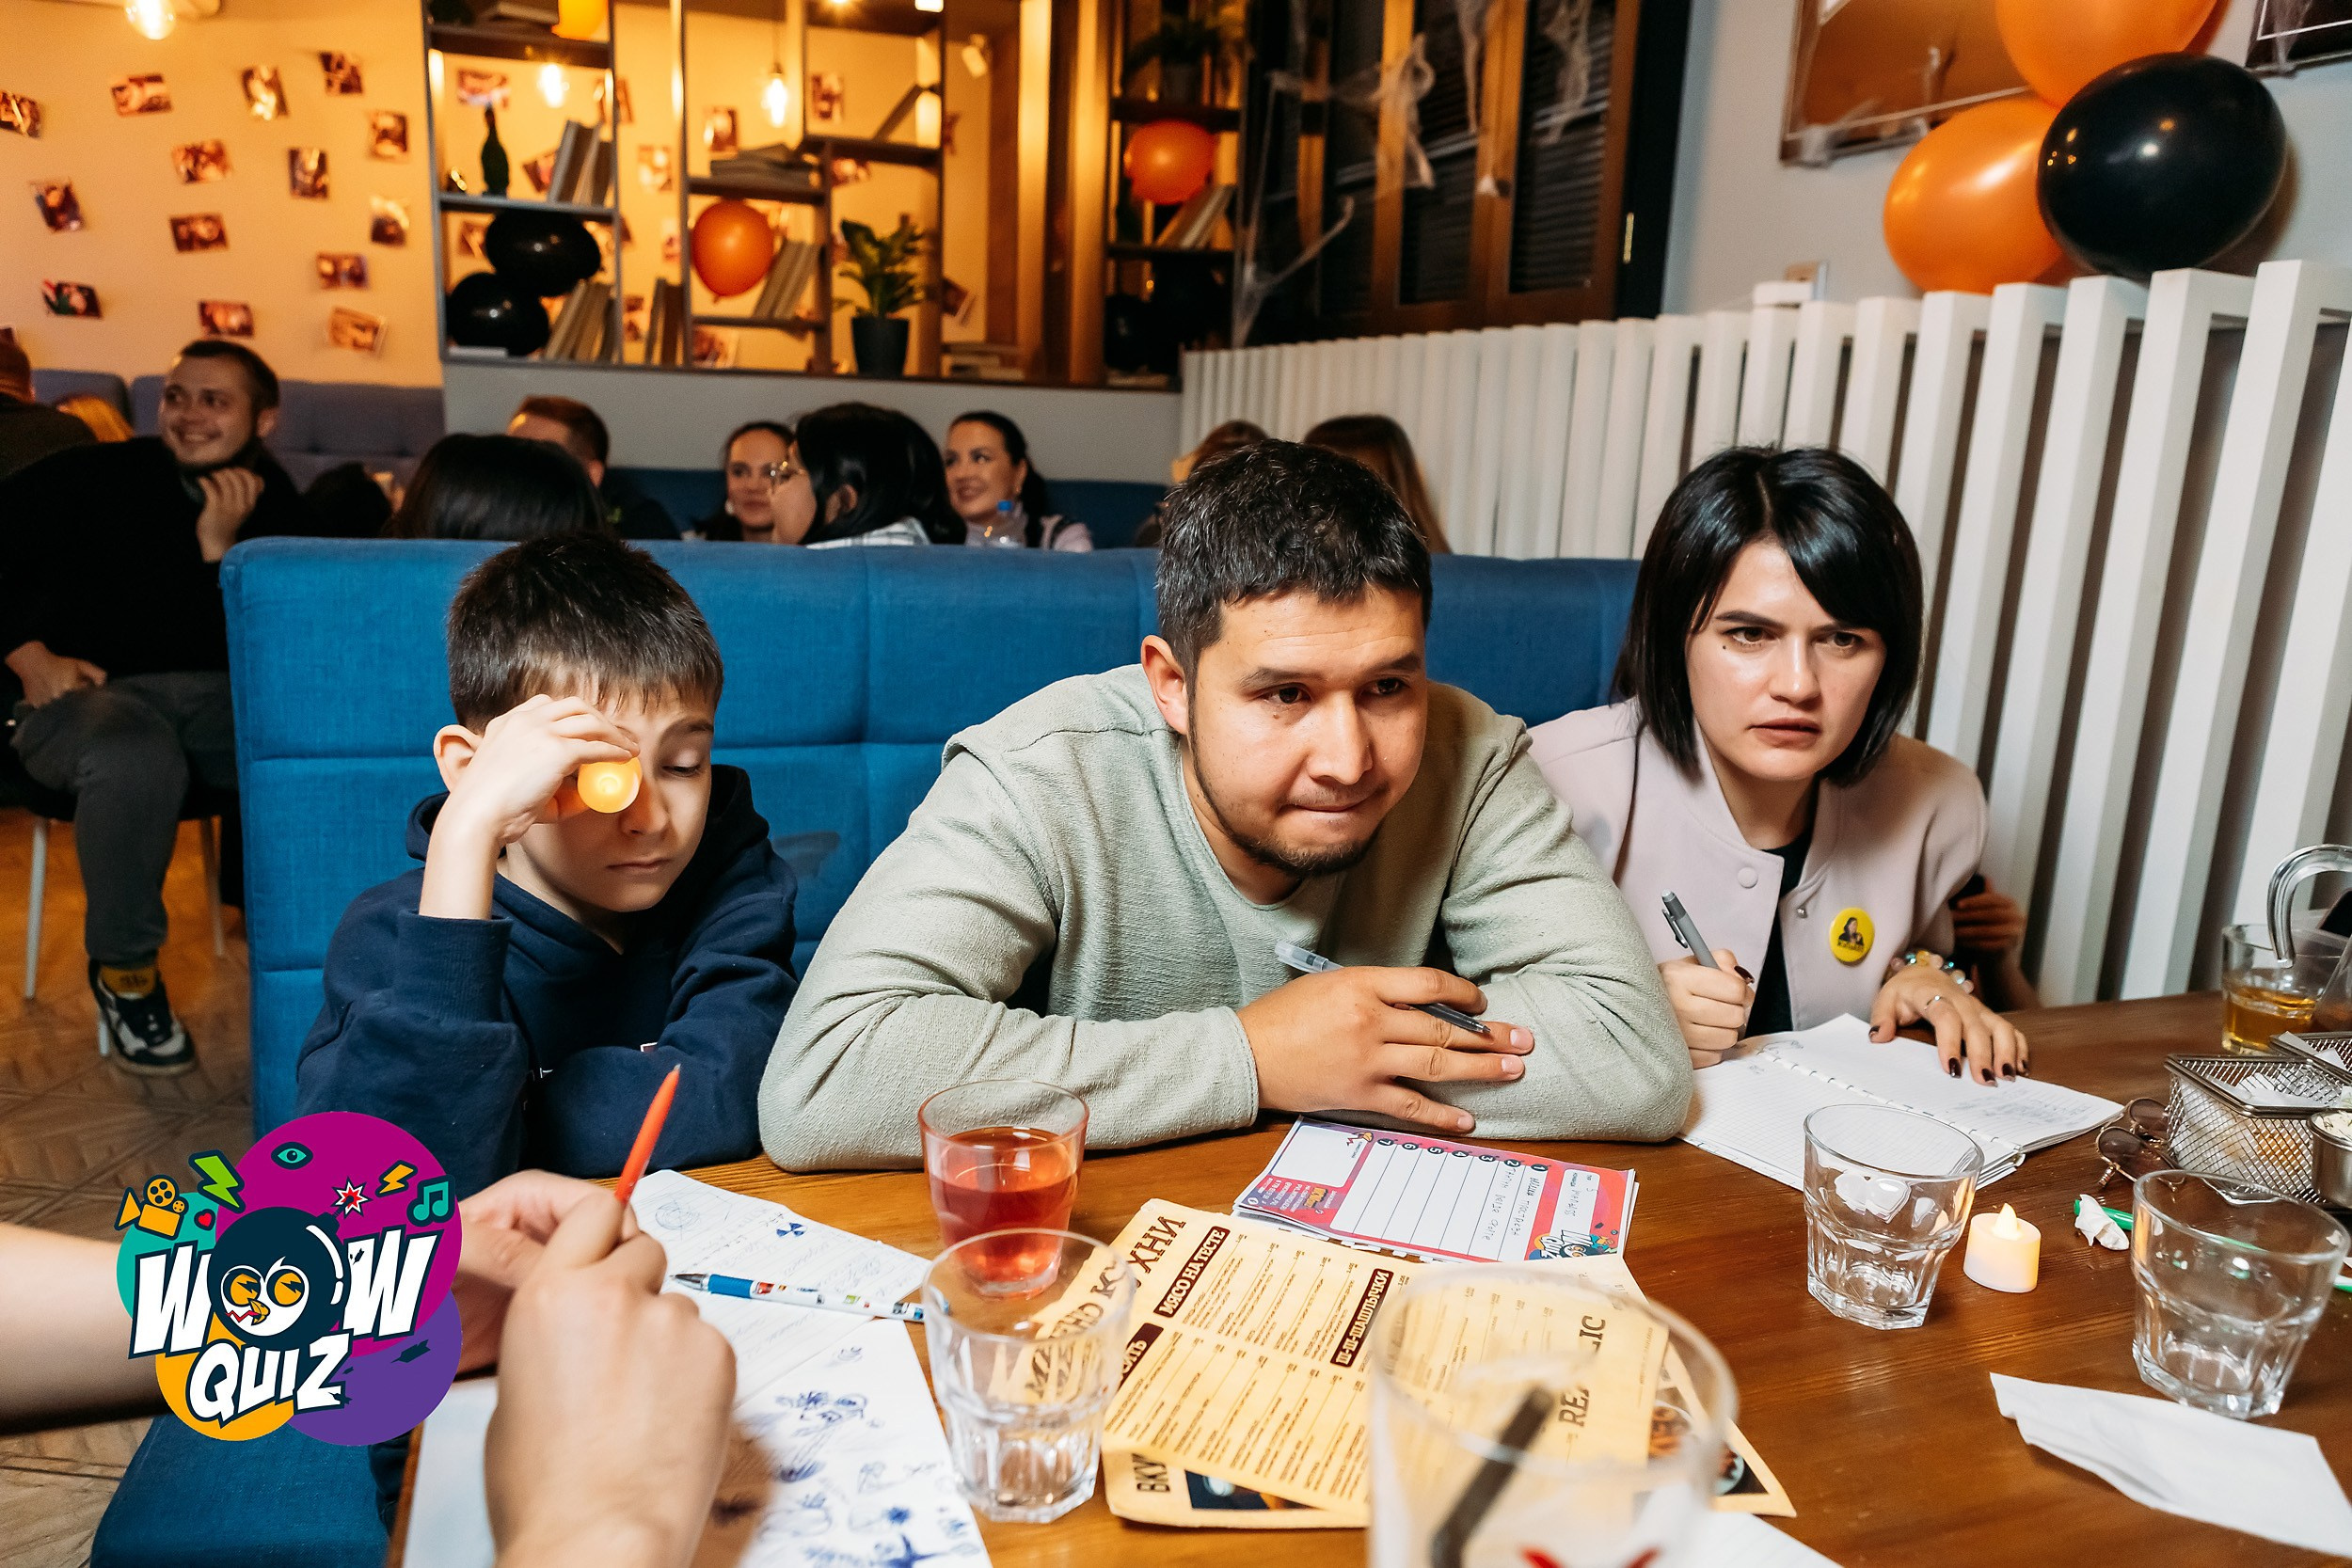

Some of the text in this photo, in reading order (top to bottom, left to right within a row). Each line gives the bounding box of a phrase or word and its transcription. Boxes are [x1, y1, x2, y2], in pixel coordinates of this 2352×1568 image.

[1193, 1229, 1226, 1262] ТЕСТЕ
[1182, 1260, 1205, 1280] НА
[1158, 1278, 1191, 1315] МЯСО
[1335, 1270, 1390, 1365] Ш-Ш-ШАШЛЫЧКИ
